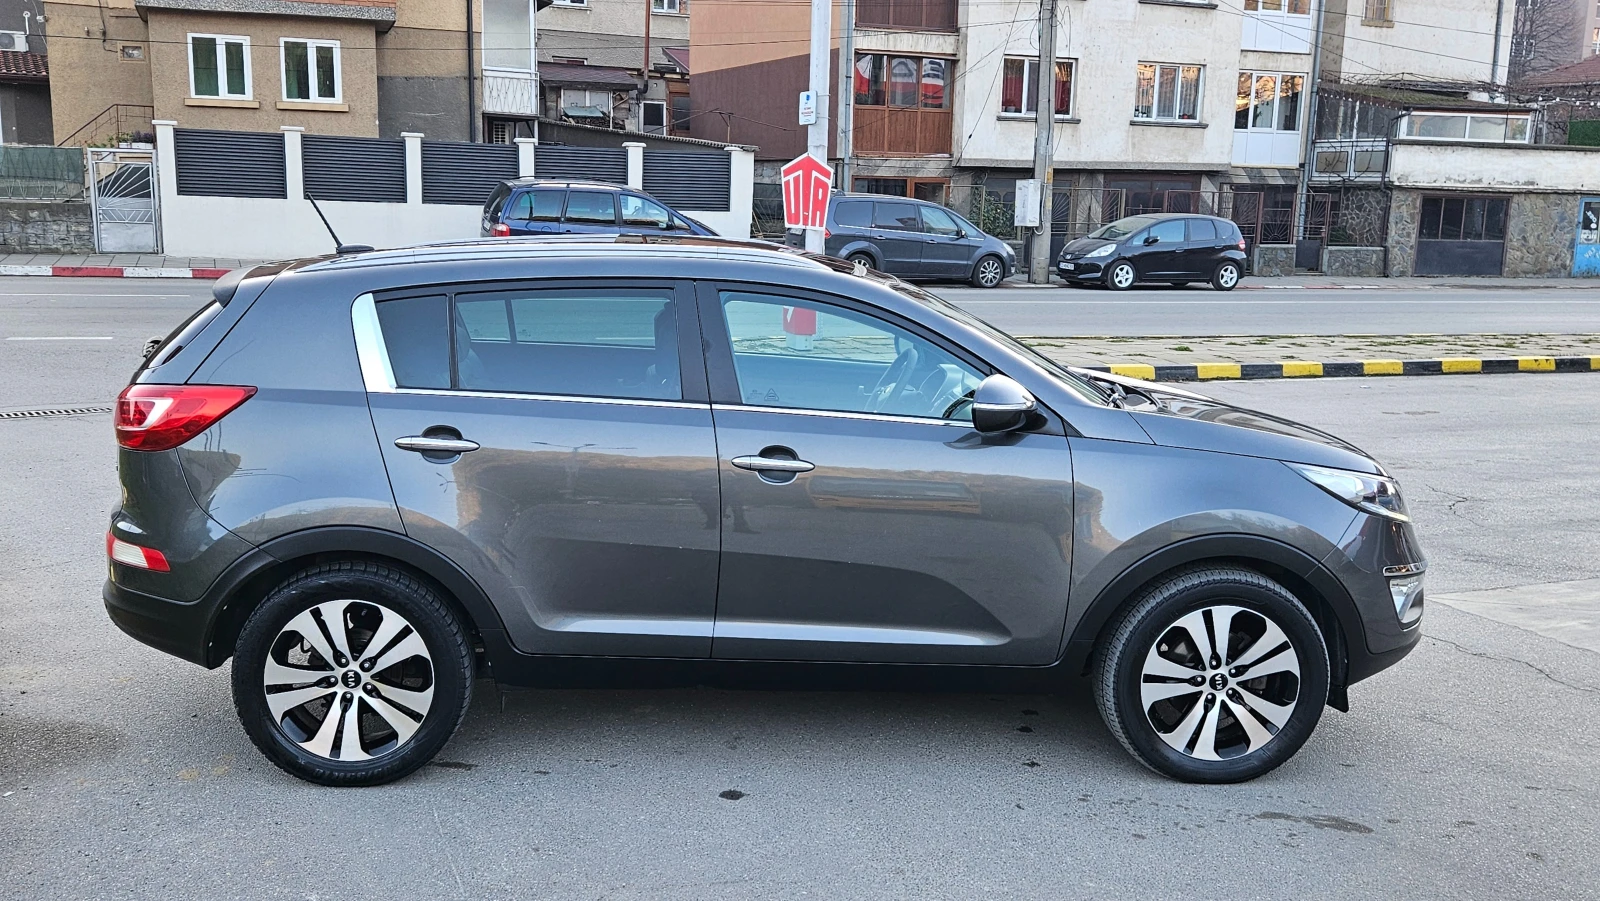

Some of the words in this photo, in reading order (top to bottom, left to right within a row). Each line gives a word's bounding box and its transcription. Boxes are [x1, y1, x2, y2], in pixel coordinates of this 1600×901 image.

[783, 155, 831, 227] UTA
[347, 671, 356, 688] KIA
[1215, 673, 1223, 690] KIA
